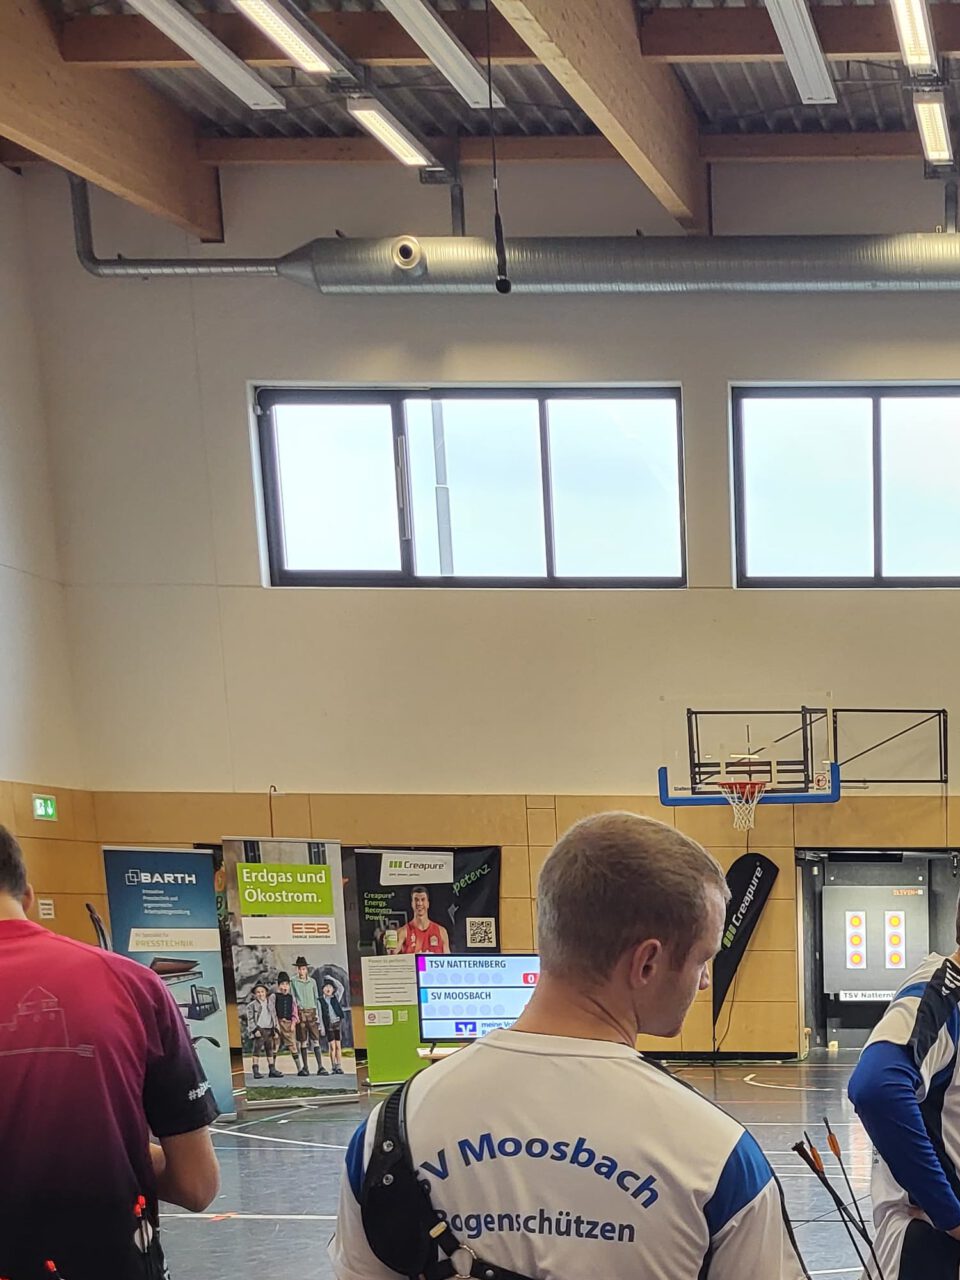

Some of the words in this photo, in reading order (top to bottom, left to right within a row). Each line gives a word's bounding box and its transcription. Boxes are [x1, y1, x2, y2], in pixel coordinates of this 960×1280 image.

[403, 860, 445, 871] Creapure
[140, 872, 197, 885] BARTH
[242, 868, 293, 887] Erdgas
[296, 870, 326, 884] und
[244, 885, 322, 903] Ökostrom.
[732, 866, 763, 927] Creapure
[291, 922, 331, 934] ESB
[429, 960, 446, 969] TSV
[447, 960, 507, 969] NATTERNBERG
[527, 974, 535, 983] 0
[431, 992, 443, 1000] SV
[444, 991, 492, 1000] MOOSBACH
[457, 1132, 660, 1210] Moosbach
